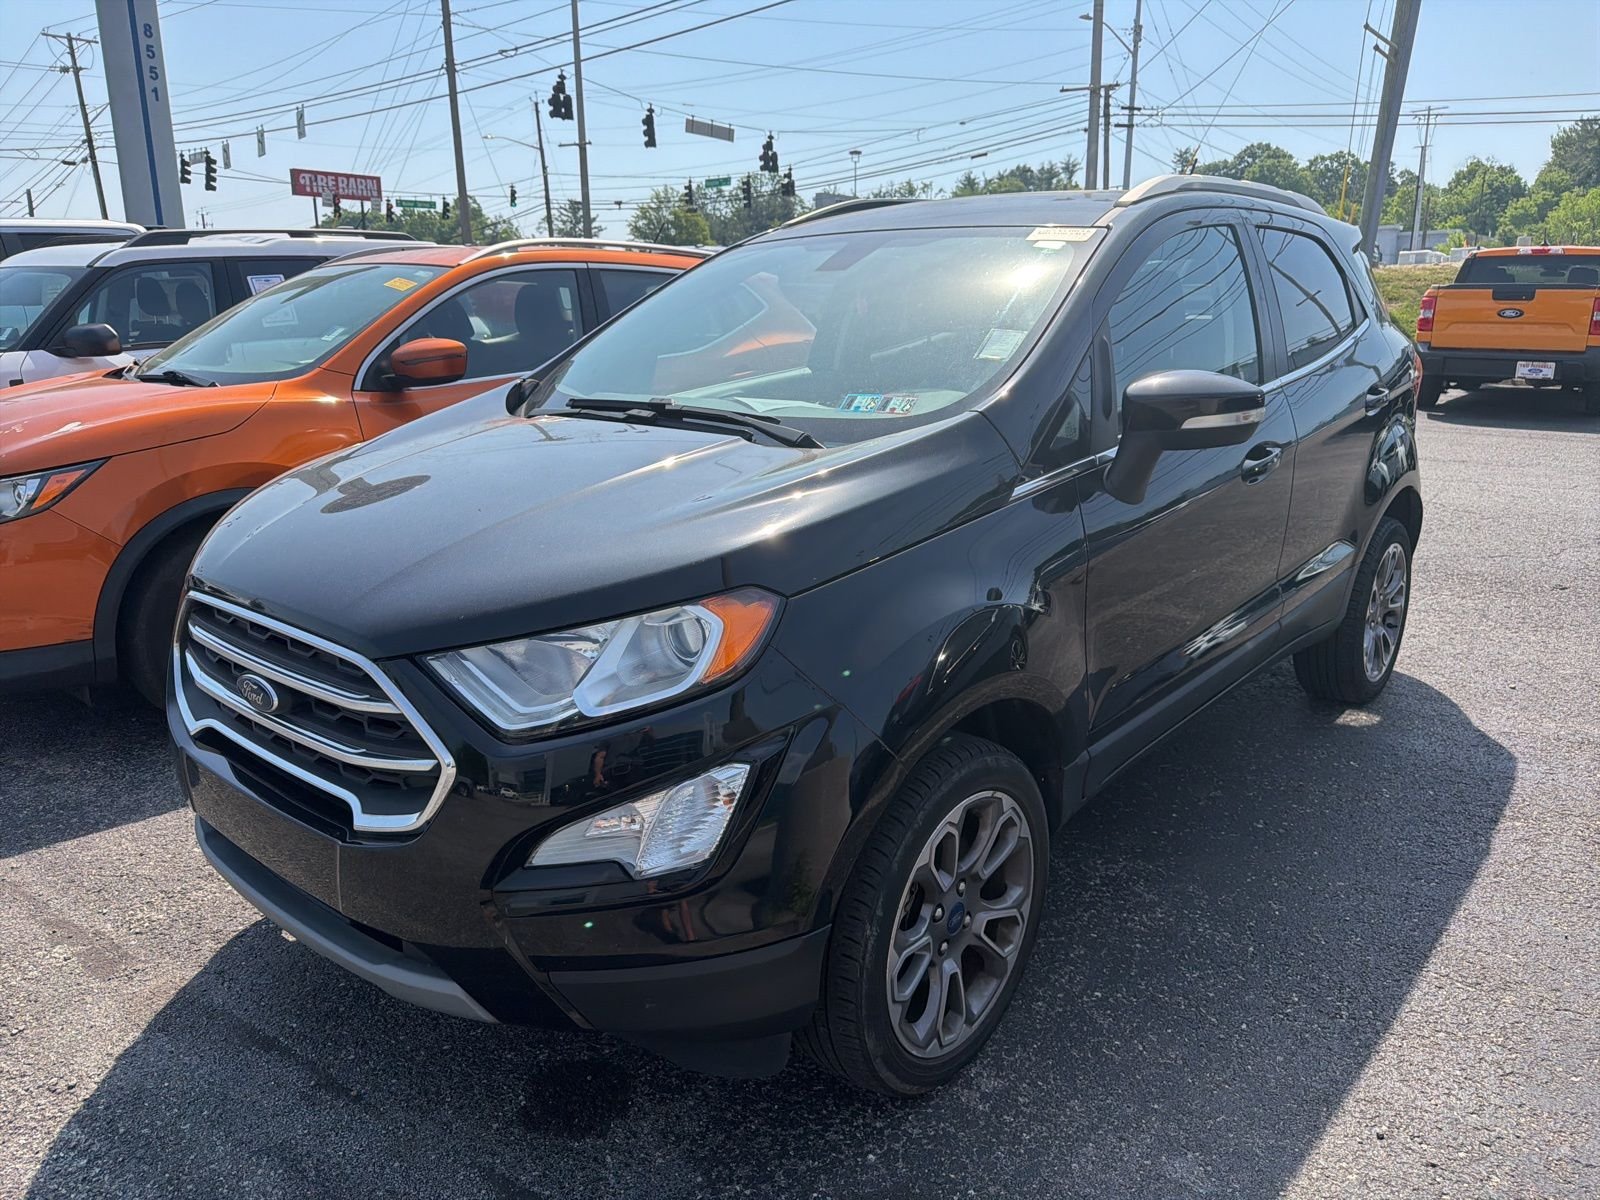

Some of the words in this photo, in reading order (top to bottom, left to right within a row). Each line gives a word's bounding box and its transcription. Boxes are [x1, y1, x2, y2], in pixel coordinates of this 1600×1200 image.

[143, 23, 160, 102] 8551
[299, 173, 336, 194] TIRE
[337, 176, 379, 198] BARN
[241, 680, 264, 705] Ford
